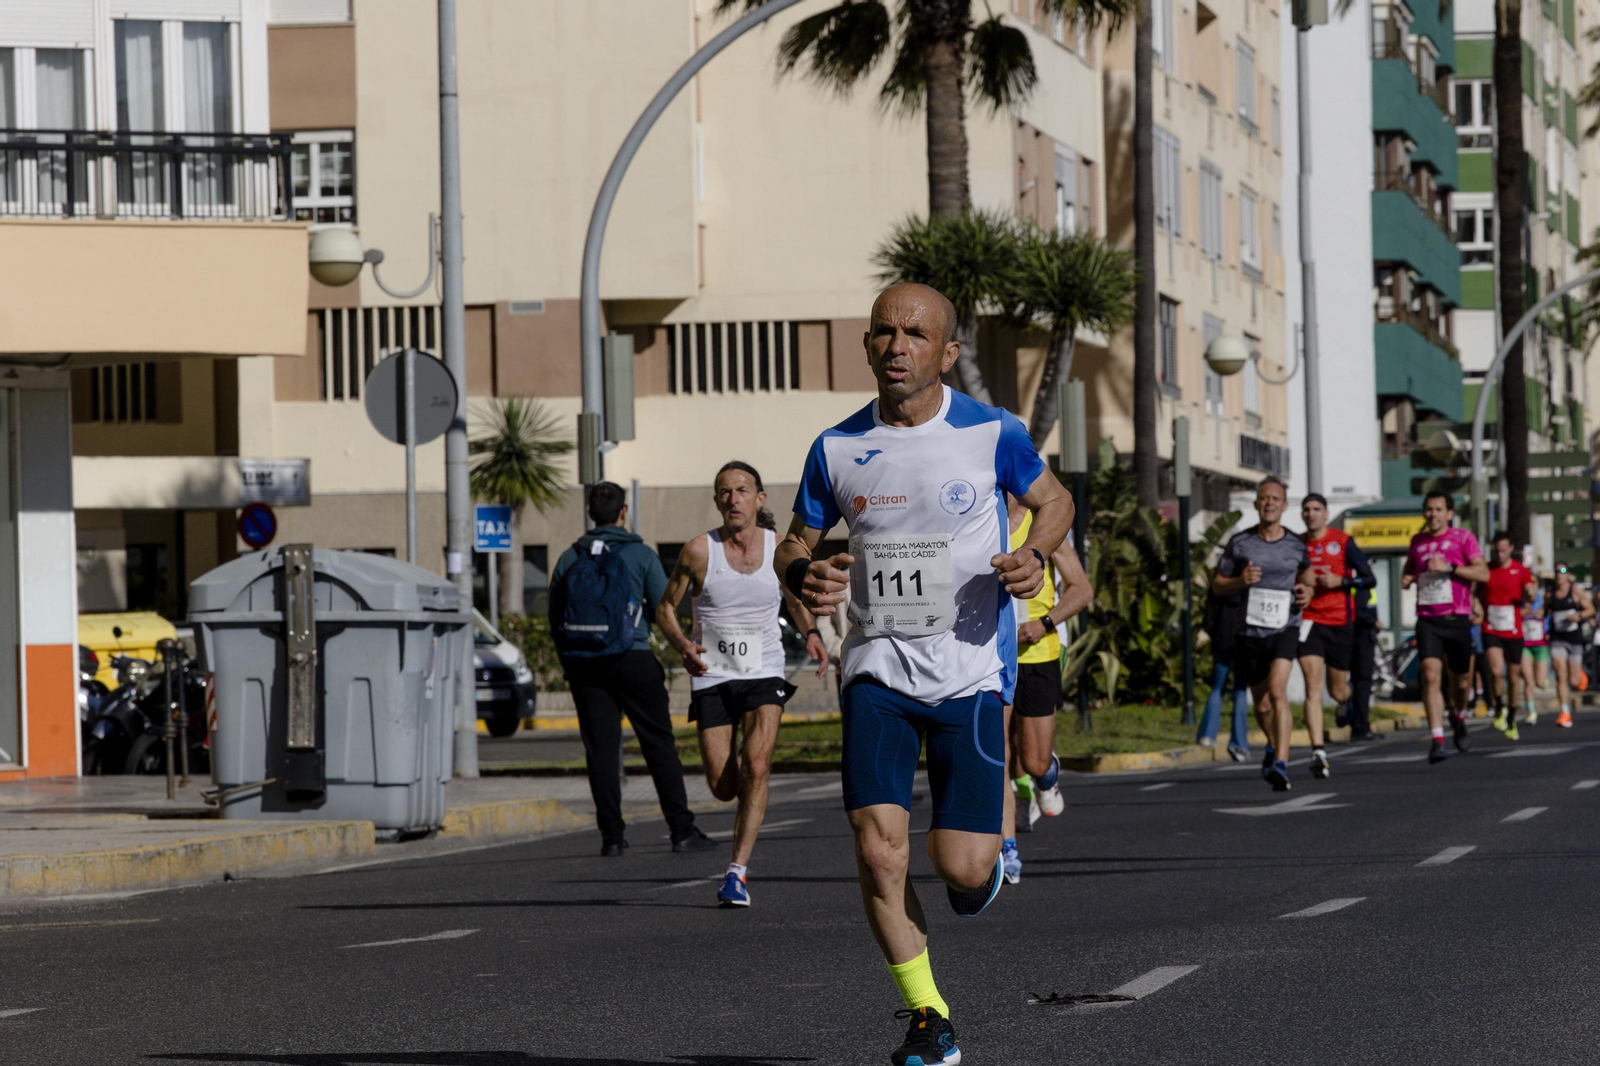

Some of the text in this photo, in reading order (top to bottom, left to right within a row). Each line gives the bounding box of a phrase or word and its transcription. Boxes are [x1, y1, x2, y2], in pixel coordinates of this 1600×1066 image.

[870, 494, 907, 506] Citran
[863, 542, 881, 550] XXXV
[909, 540, 948, 549] MARATÓN
[874, 550, 937, 559] BAHÍA DE CÁDIZ
[872, 569, 924, 597] 111
[1260, 601, 1279, 613] 151
[718, 640, 748, 656] 610
